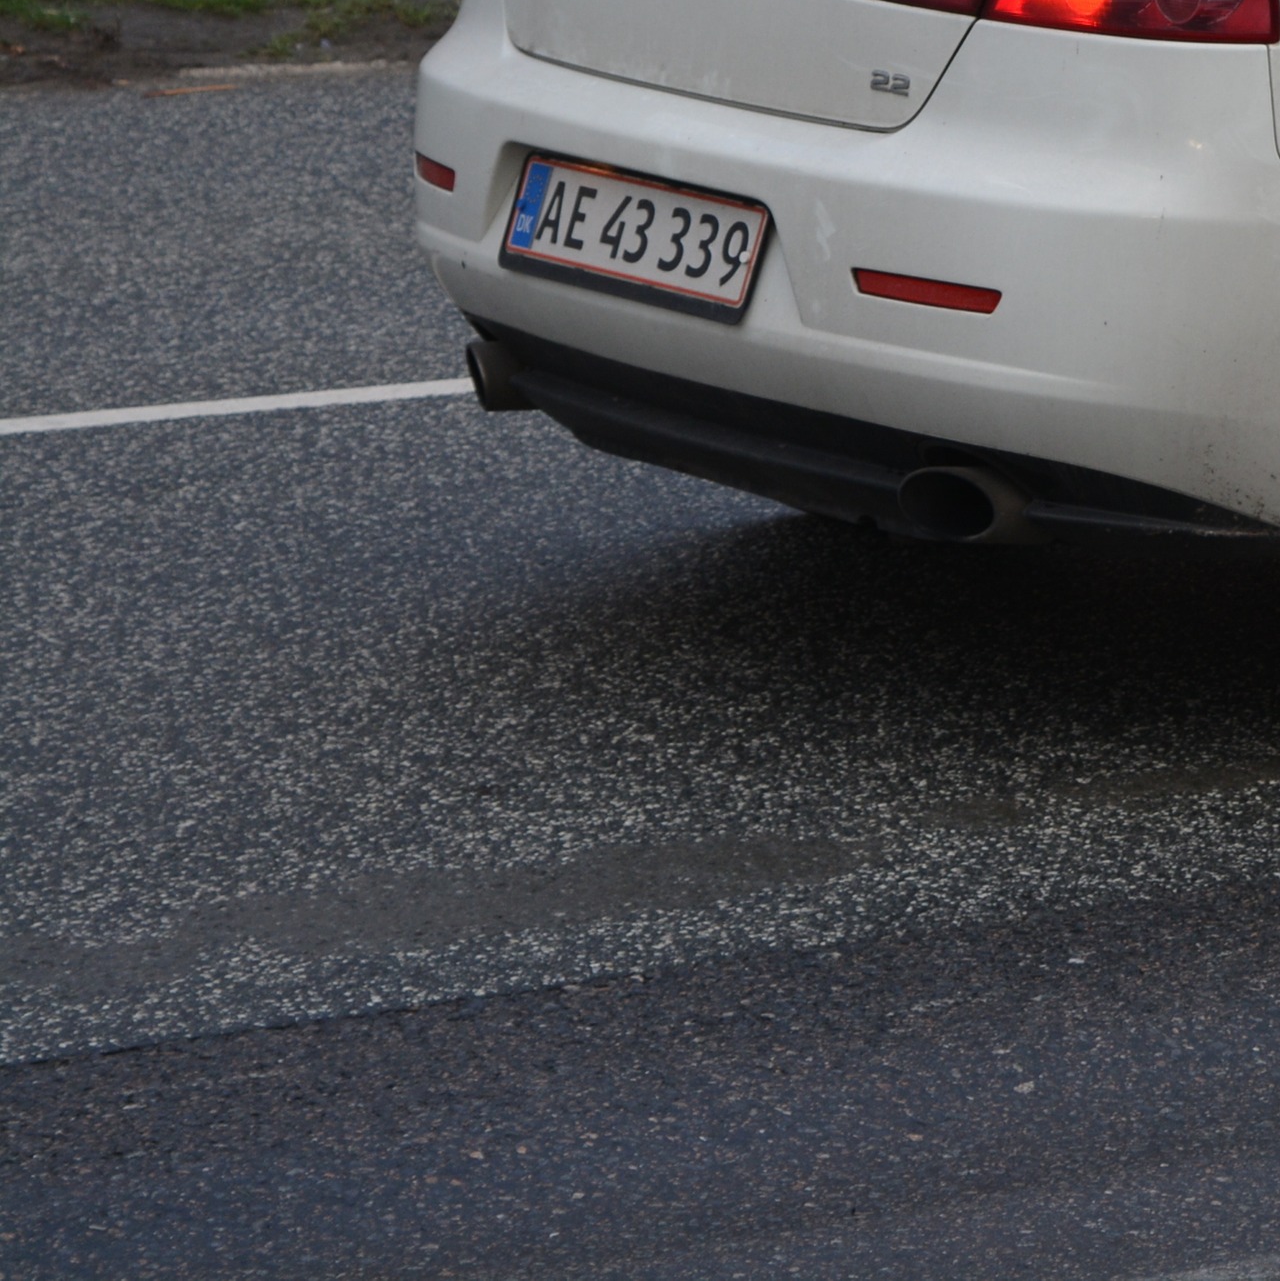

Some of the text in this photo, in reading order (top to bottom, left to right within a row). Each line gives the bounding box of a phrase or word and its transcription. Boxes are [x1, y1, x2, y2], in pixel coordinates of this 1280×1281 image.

[516, 213, 533, 234] DK
[535, 181, 750, 287] AE 43 339
